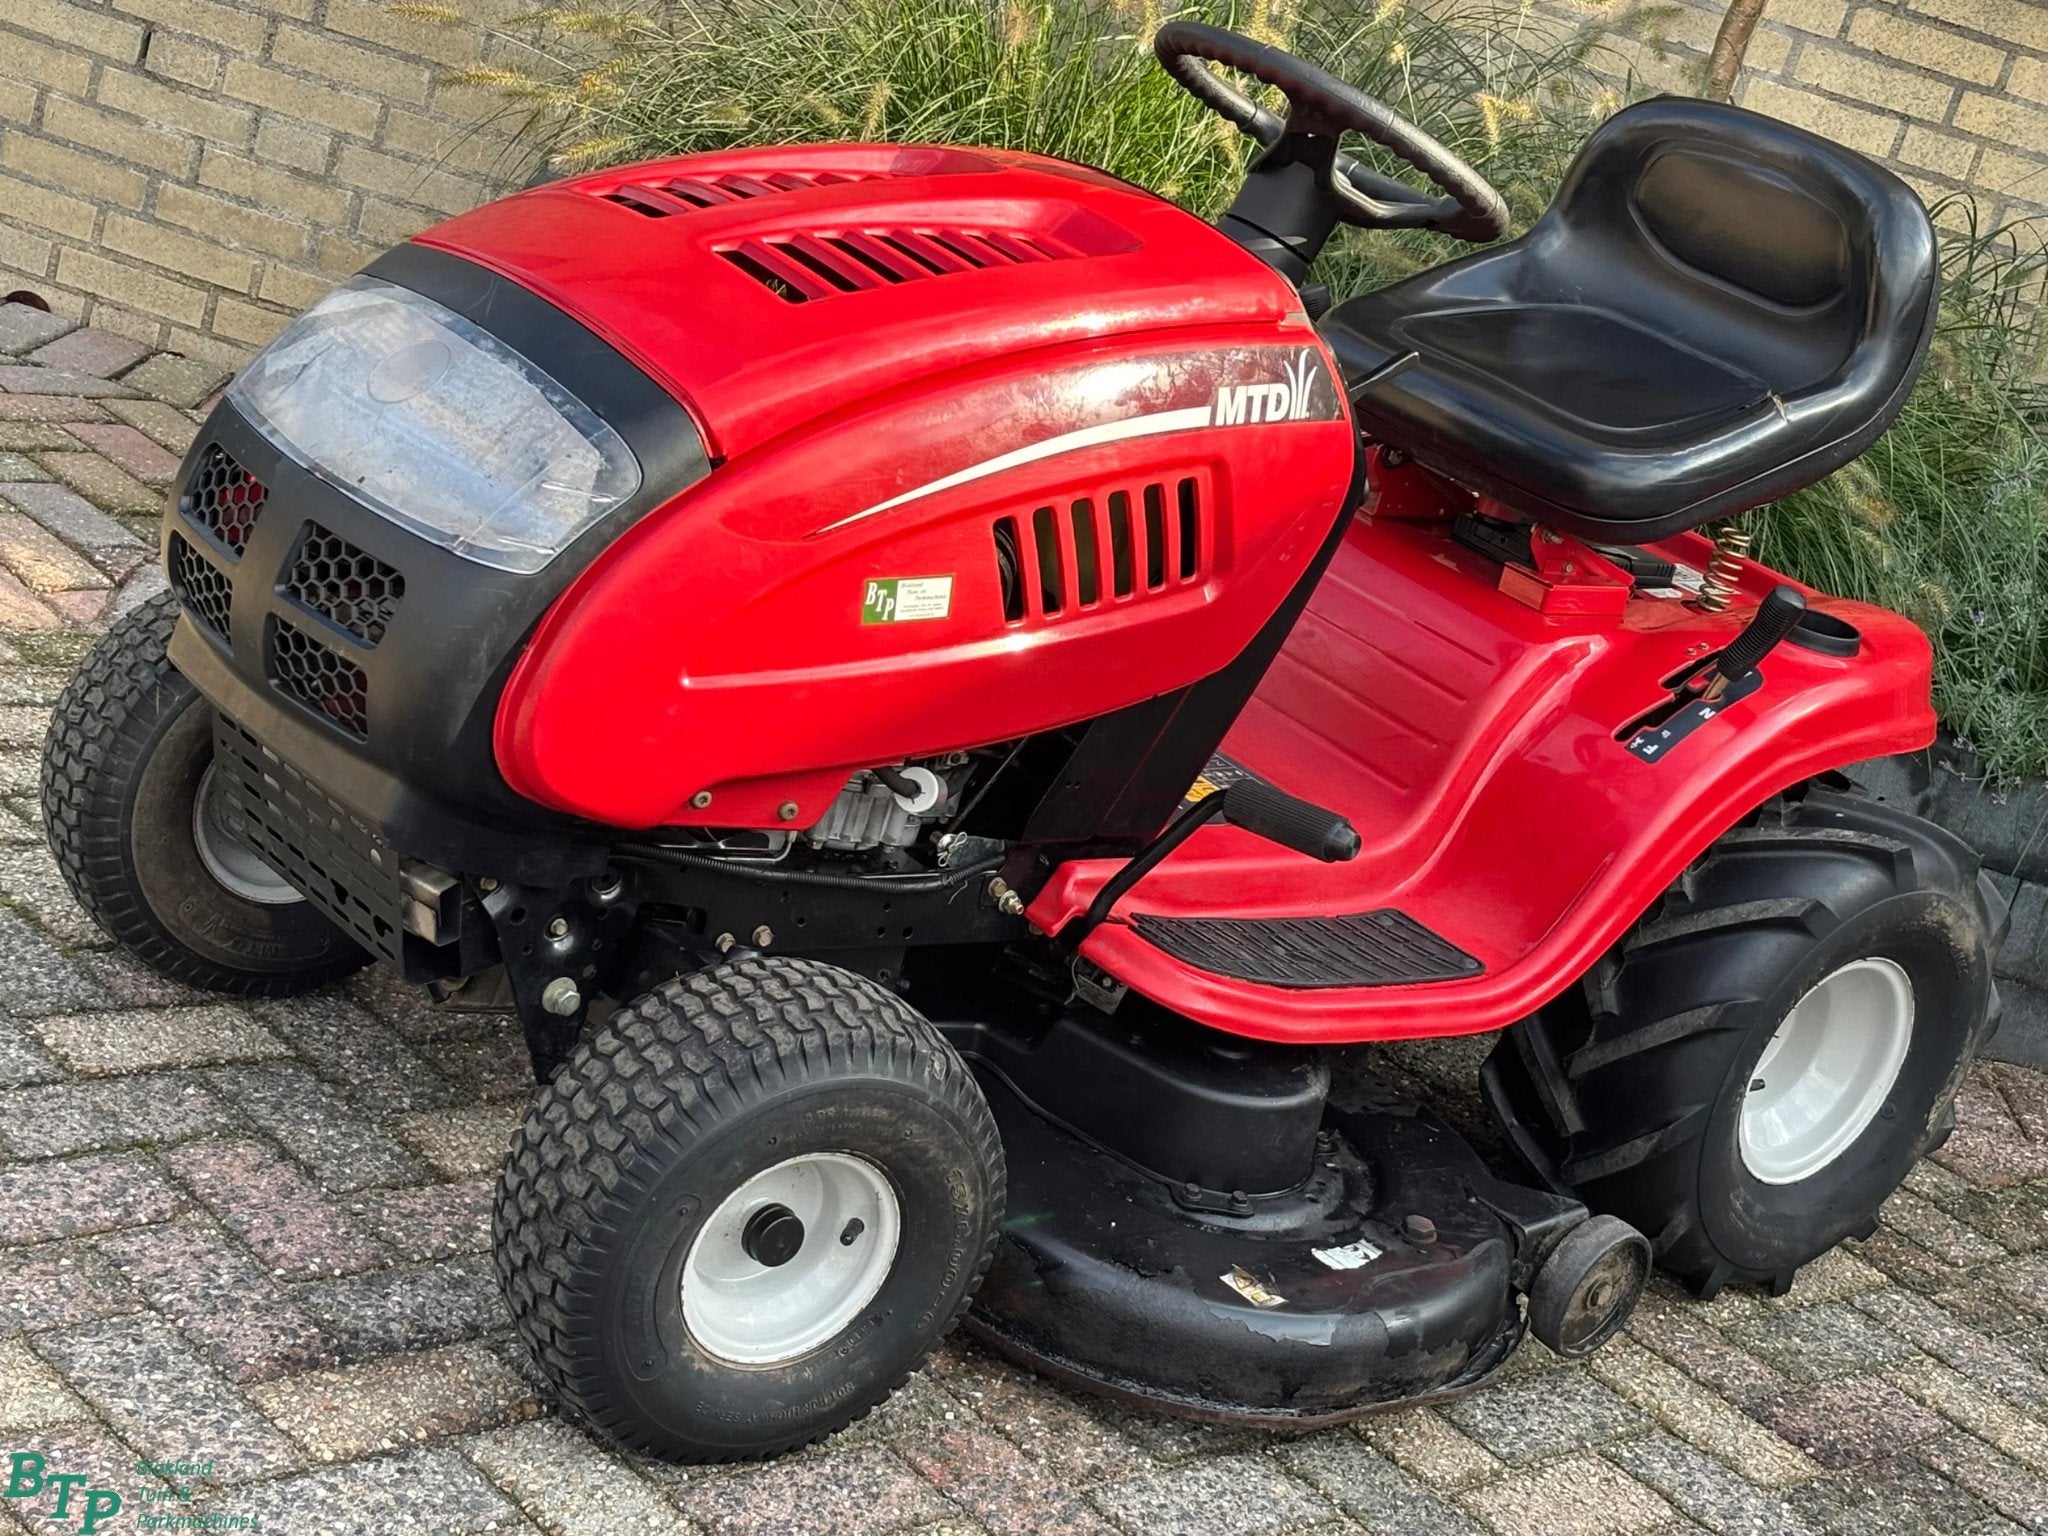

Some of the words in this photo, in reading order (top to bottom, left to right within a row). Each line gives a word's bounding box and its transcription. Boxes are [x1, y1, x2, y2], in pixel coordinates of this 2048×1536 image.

[1215, 383, 1290, 426] MTD
[865, 582, 895, 621] BTP
[1699, 707, 1716, 719] N
[1643, 745, 1659, 755] F
